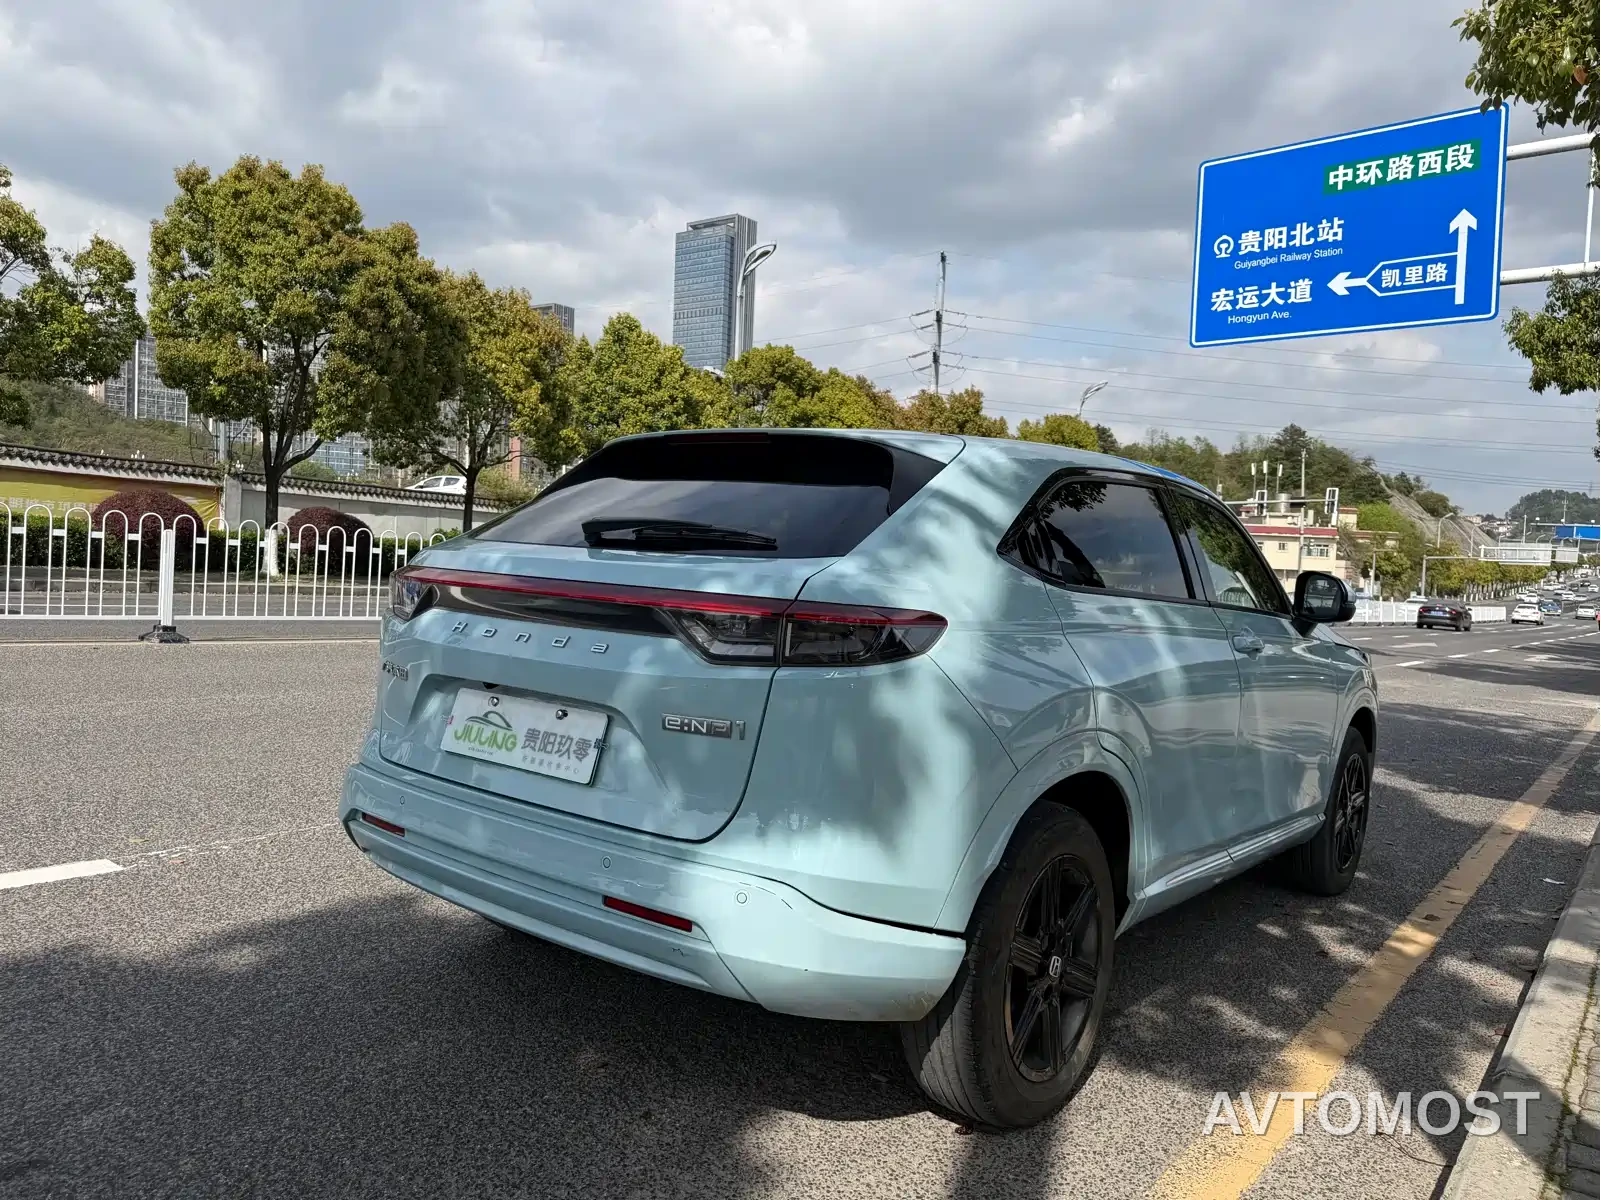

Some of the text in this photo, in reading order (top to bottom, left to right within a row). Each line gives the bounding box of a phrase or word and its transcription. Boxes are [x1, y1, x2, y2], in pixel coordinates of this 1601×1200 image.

[1328, 143, 1475, 191] 中环路西段
[1238, 216, 1345, 256] 贵阳北站
[1234, 246, 1343, 270] Guiyangbei Railway Station
[1381, 262, 1448, 289] 凯里路
[1210, 278, 1313, 313] 宏运大道
[1227, 310, 1293, 325] Hongyun Ave.
[451, 621, 609, 654] Honda
[454, 723, 518, 753] JIULING
[521, 727, 593, 763] 贵阳玖零
